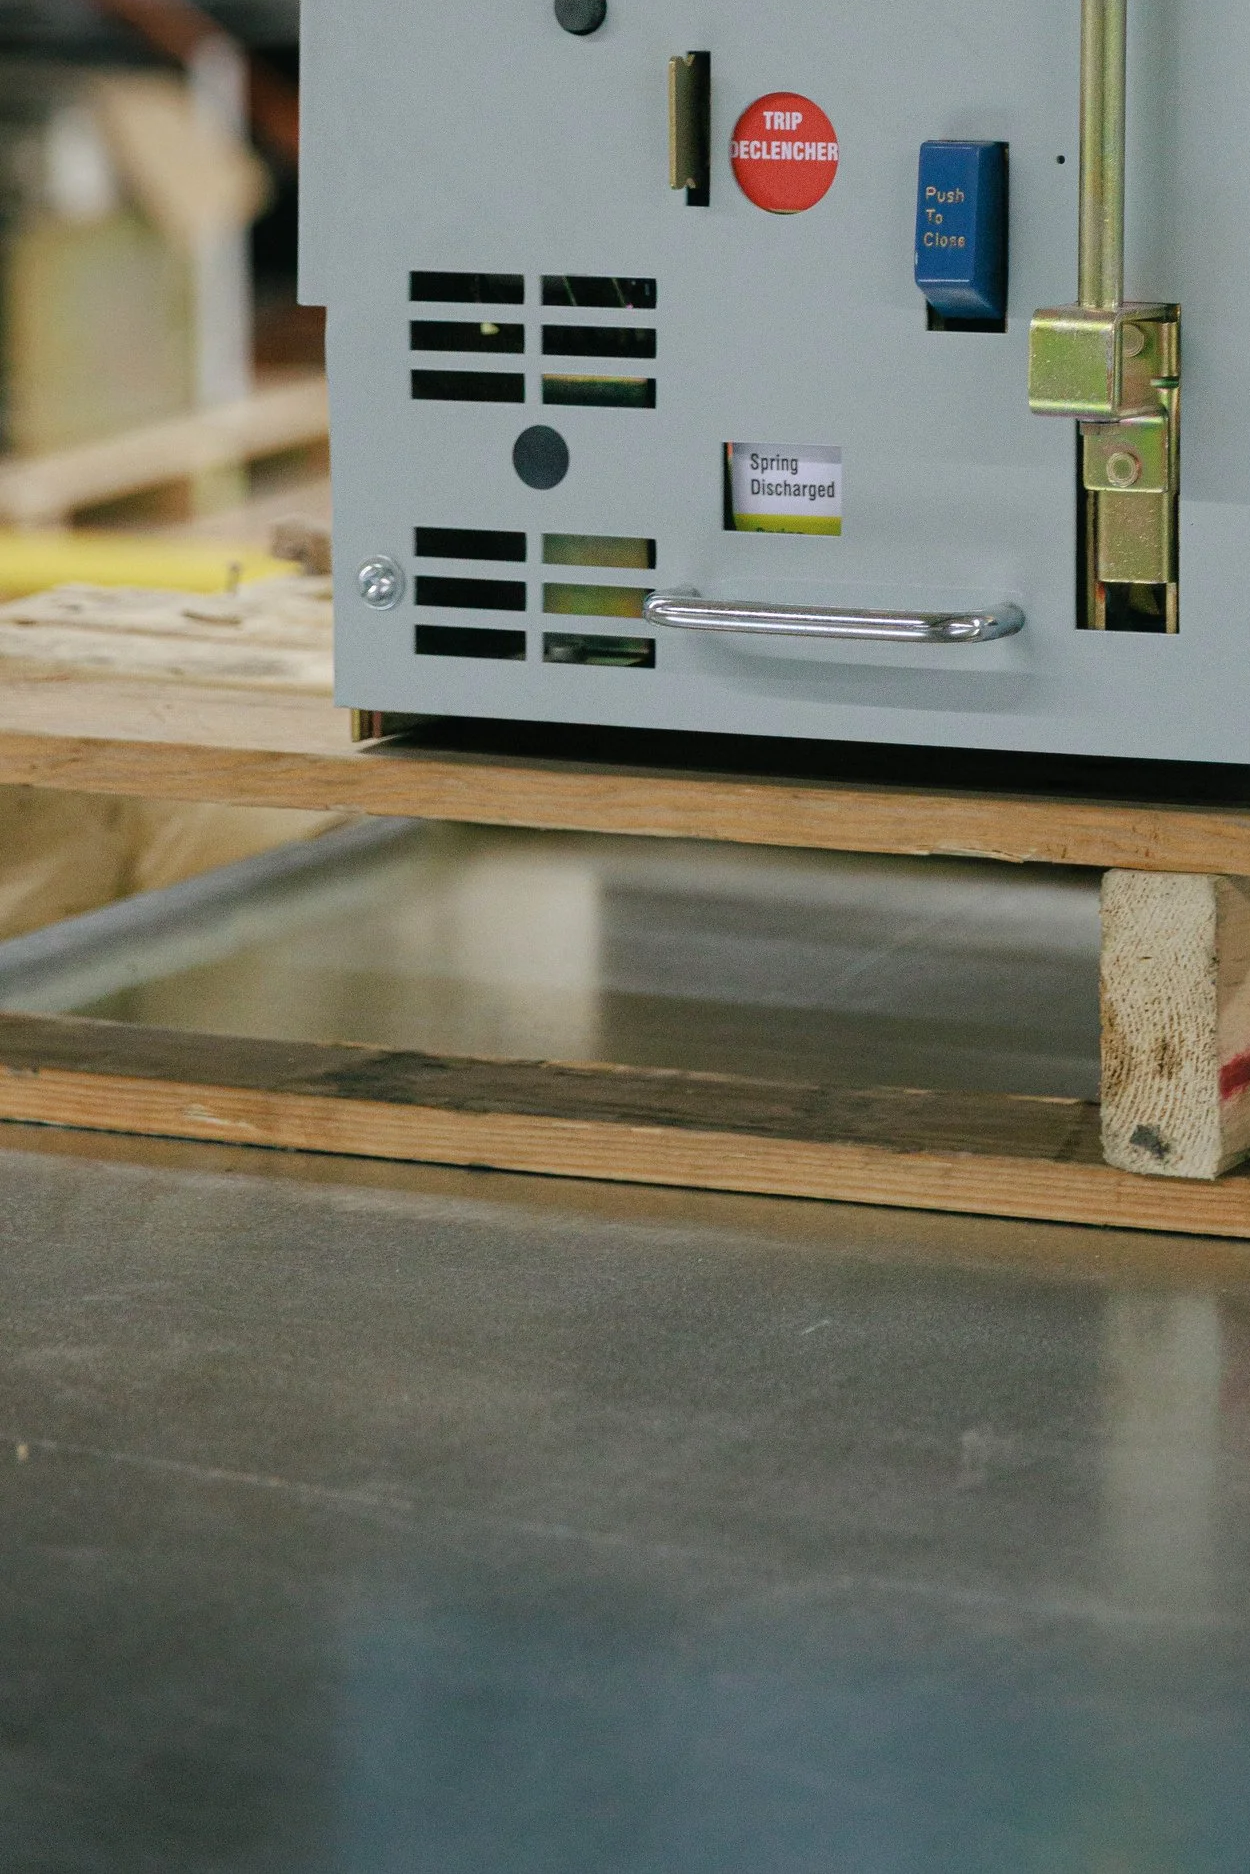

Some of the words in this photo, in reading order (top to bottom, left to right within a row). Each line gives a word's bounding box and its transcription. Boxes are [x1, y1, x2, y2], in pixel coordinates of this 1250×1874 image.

[763, 112, 802, 130] TRIP
[926, 187, 964, 203] Push
[926, 209, 942, 225] To
[924, 232, 965, 247] Close
[751, 453, 798, 474] Spring
[751, 479, 835, 500] Discharged
